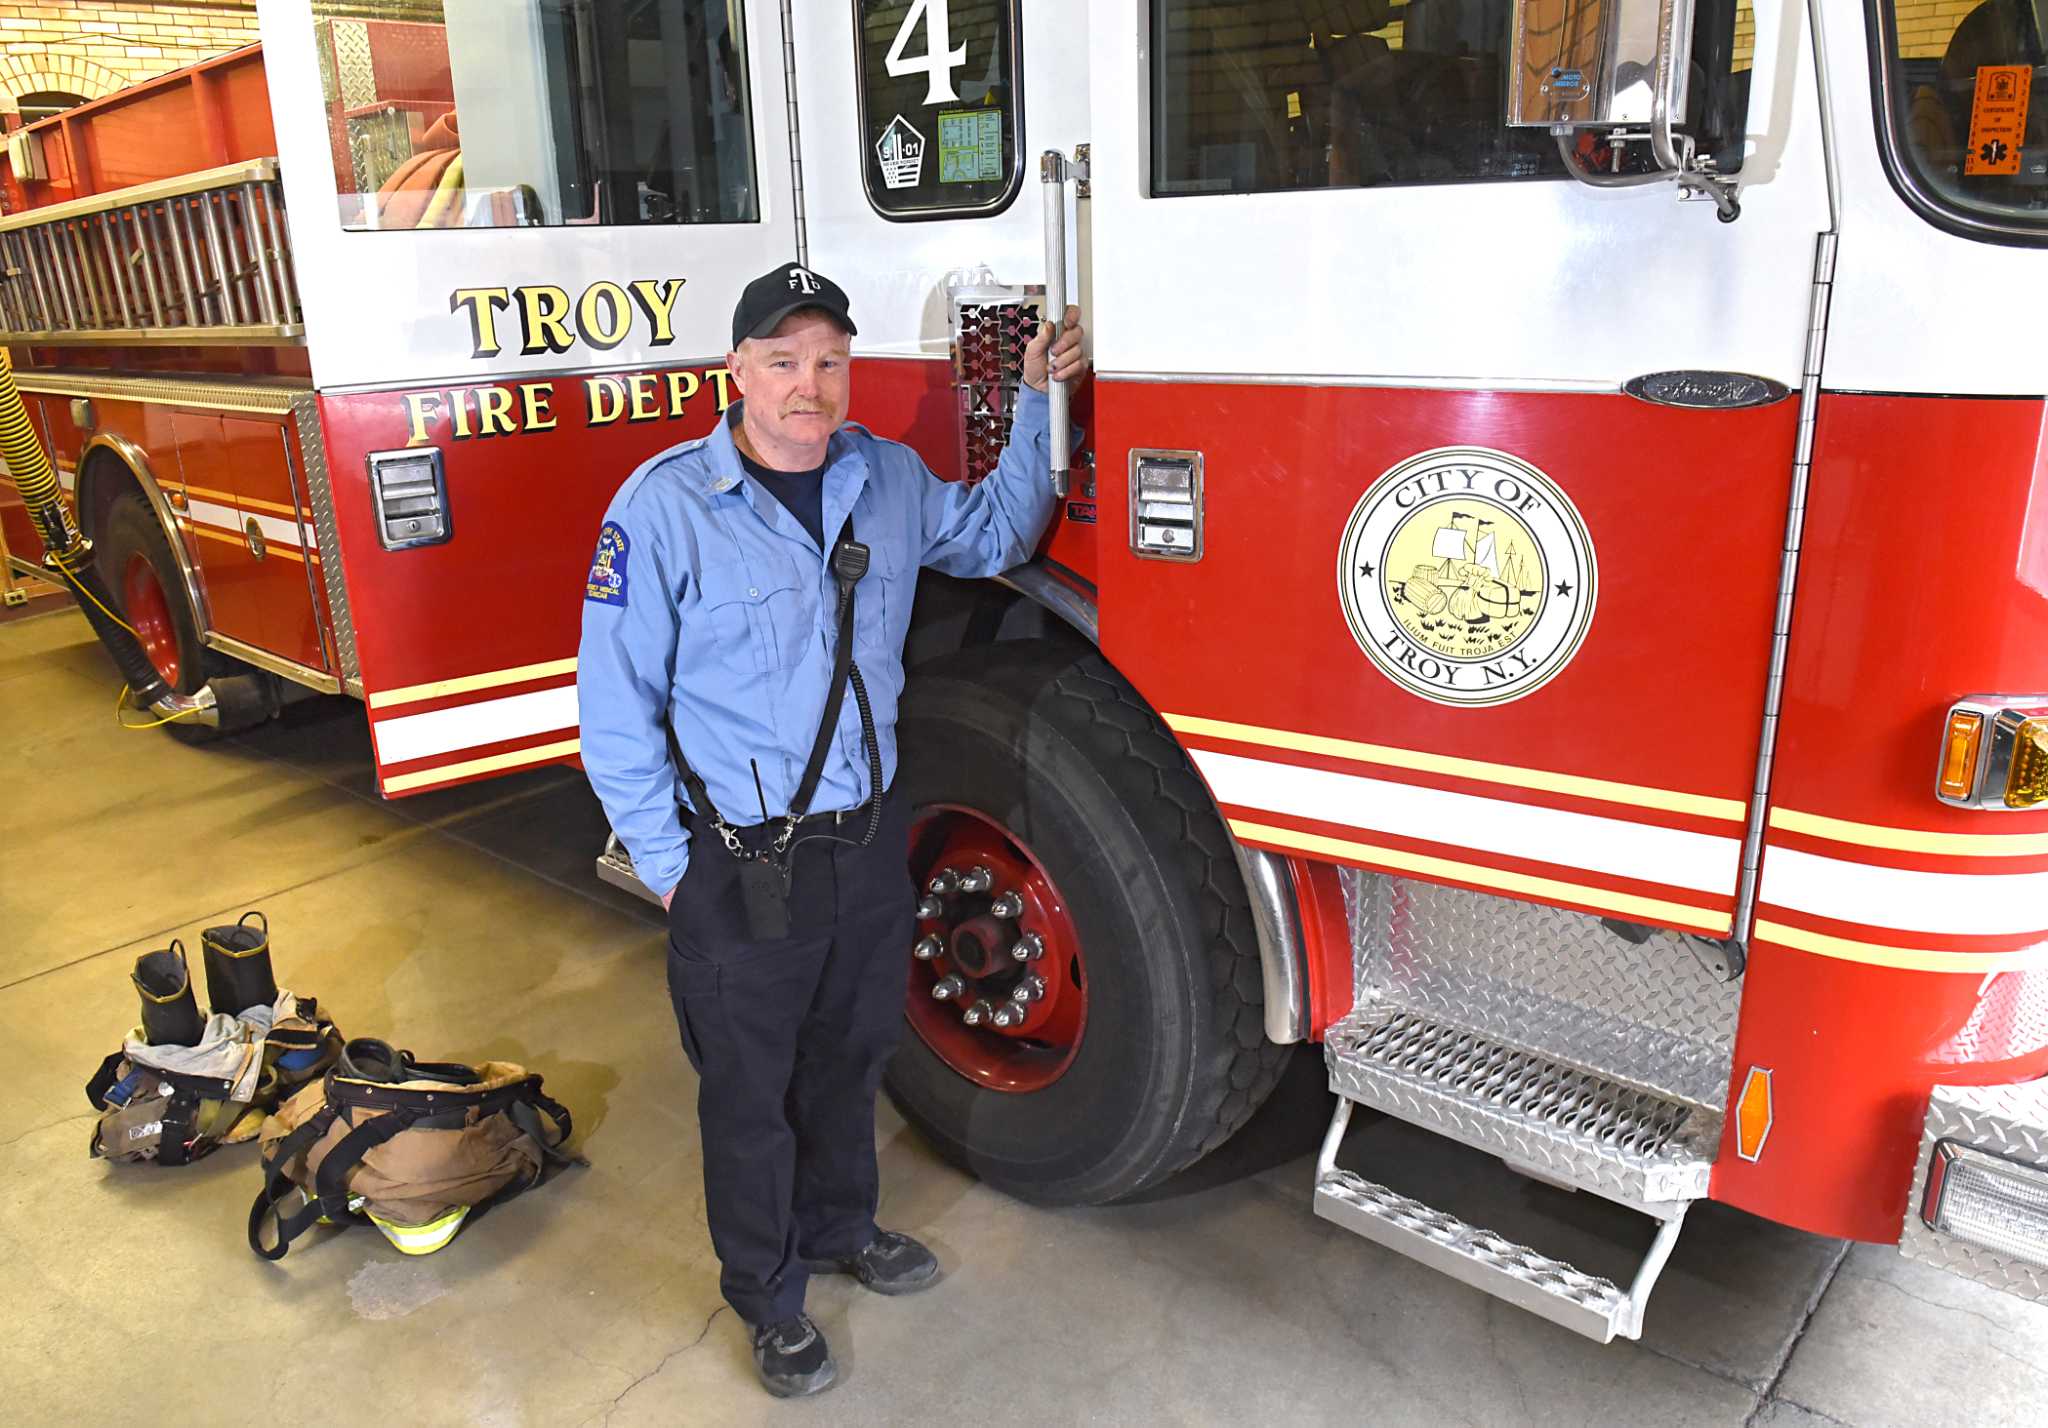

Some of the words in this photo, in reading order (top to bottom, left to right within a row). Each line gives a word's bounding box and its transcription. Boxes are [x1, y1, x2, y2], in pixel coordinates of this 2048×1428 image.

[884, 0, 968, 106] 4
[450, 279, 686, 359] TROY
[403, 383, 557, 443] FIRE
[584, 368, 731, 428] DEPT
[1394, 468, 1485, 510] CITY
[1494, 478, 1542, 514] OF
[1381, 629, 1463, 686] TROY
[1483, 647, 1538, 687] N.Y.
[1402, 617, 1429, 644] ILIUM
[1432, 640, 1456, 656] FUIT
[1459, 644, 1495, 657] TROJA
[1498, 631, 1517, 648] EST
